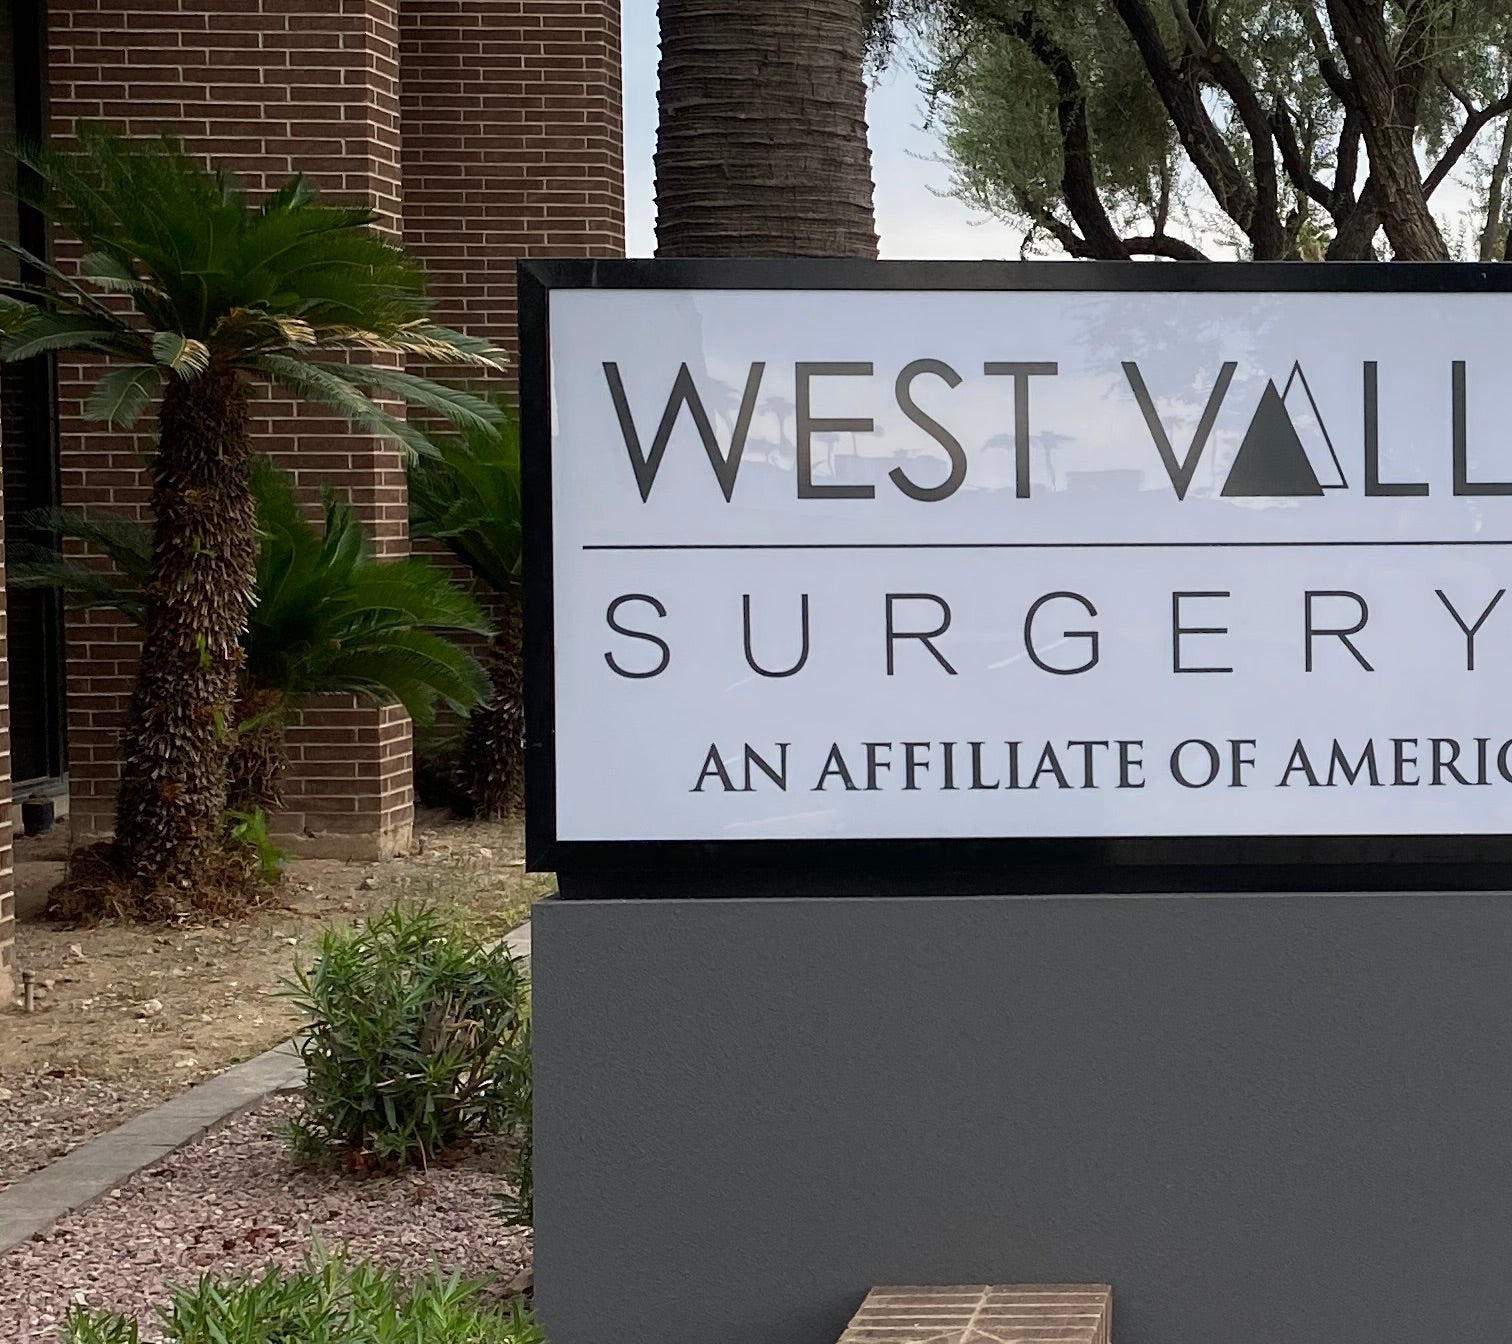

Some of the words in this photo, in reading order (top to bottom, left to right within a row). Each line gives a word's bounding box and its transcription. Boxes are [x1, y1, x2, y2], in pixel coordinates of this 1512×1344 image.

[601, 358, 1059, 504] WEST
[603, 588, 1507, 679] SURGERY
[688, 742, 792, 793] AN
[810, 740, 1146, 792] AFFILIATE
[1169, 738, 1257, 789] OF
